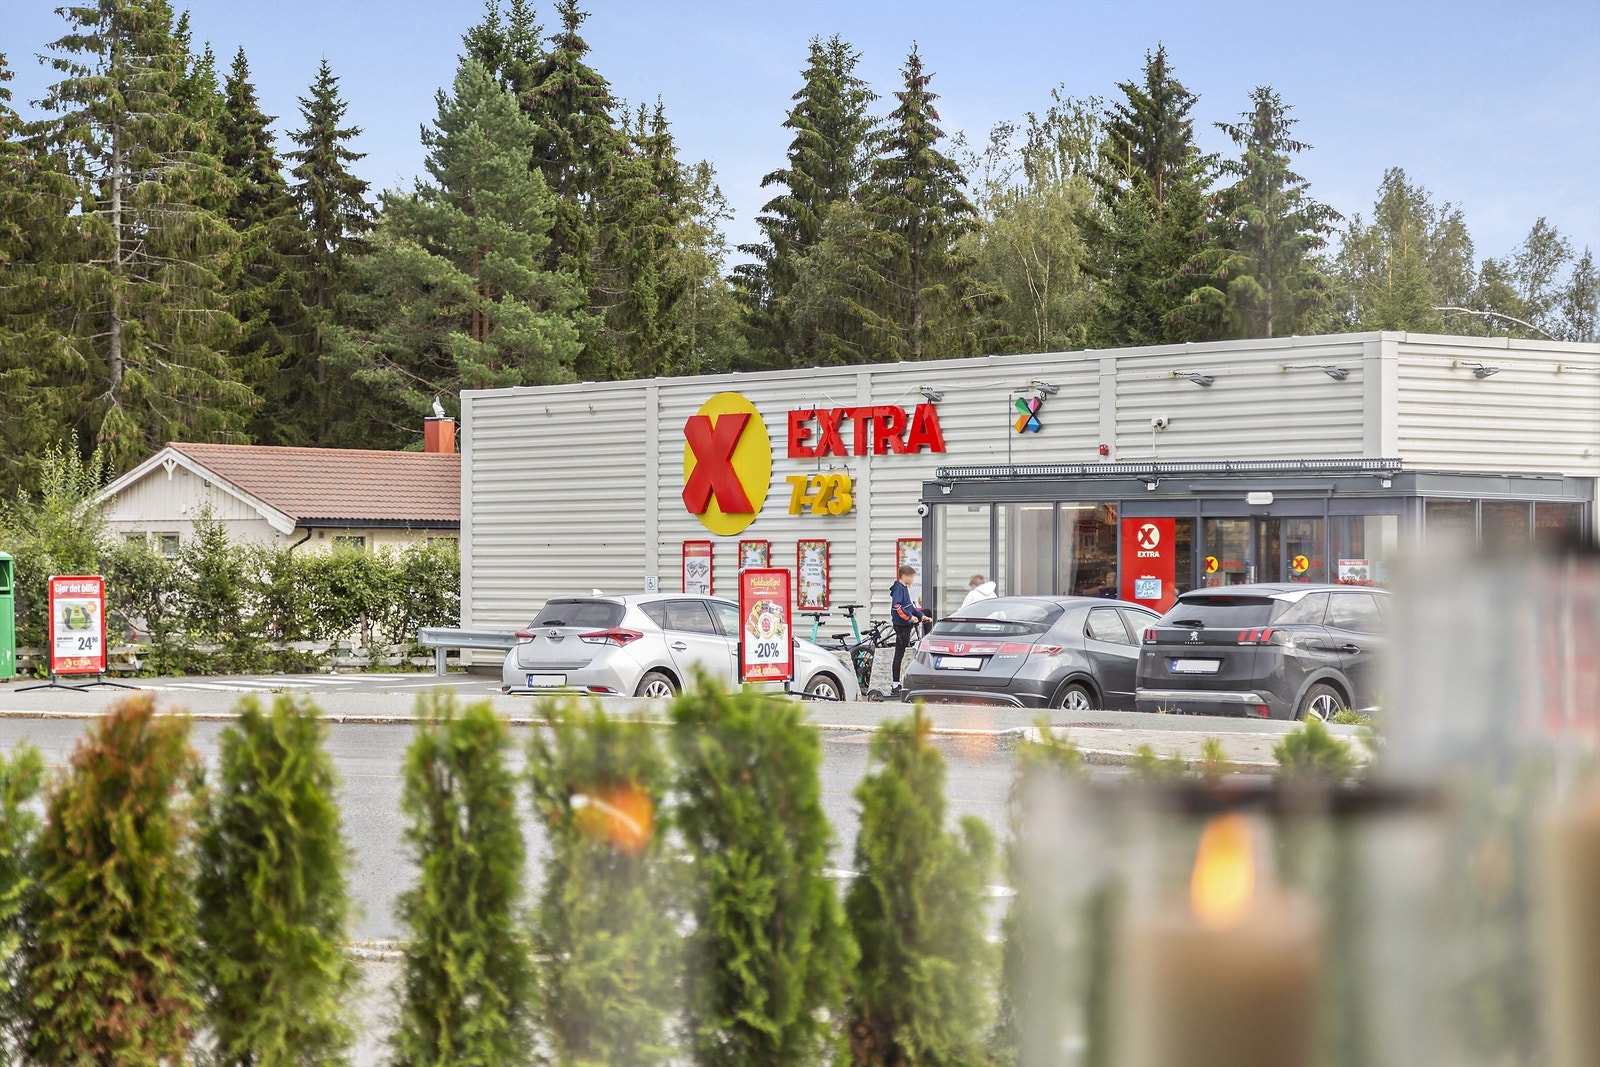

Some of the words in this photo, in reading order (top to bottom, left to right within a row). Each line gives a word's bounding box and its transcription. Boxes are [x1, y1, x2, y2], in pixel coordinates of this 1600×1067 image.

[787, 403, 947, 459] EXTRA
[682, 413, 755, 514] X
[786, 474, 853, 516] 7-23
[1137, 550, 1160, 558] EXTRA
[55, 584, 69, 595] Gjør
[70, 584, 81, 593] det
[78, 637, 92, 650] 24
[755, 642, 779, 658] -20%
